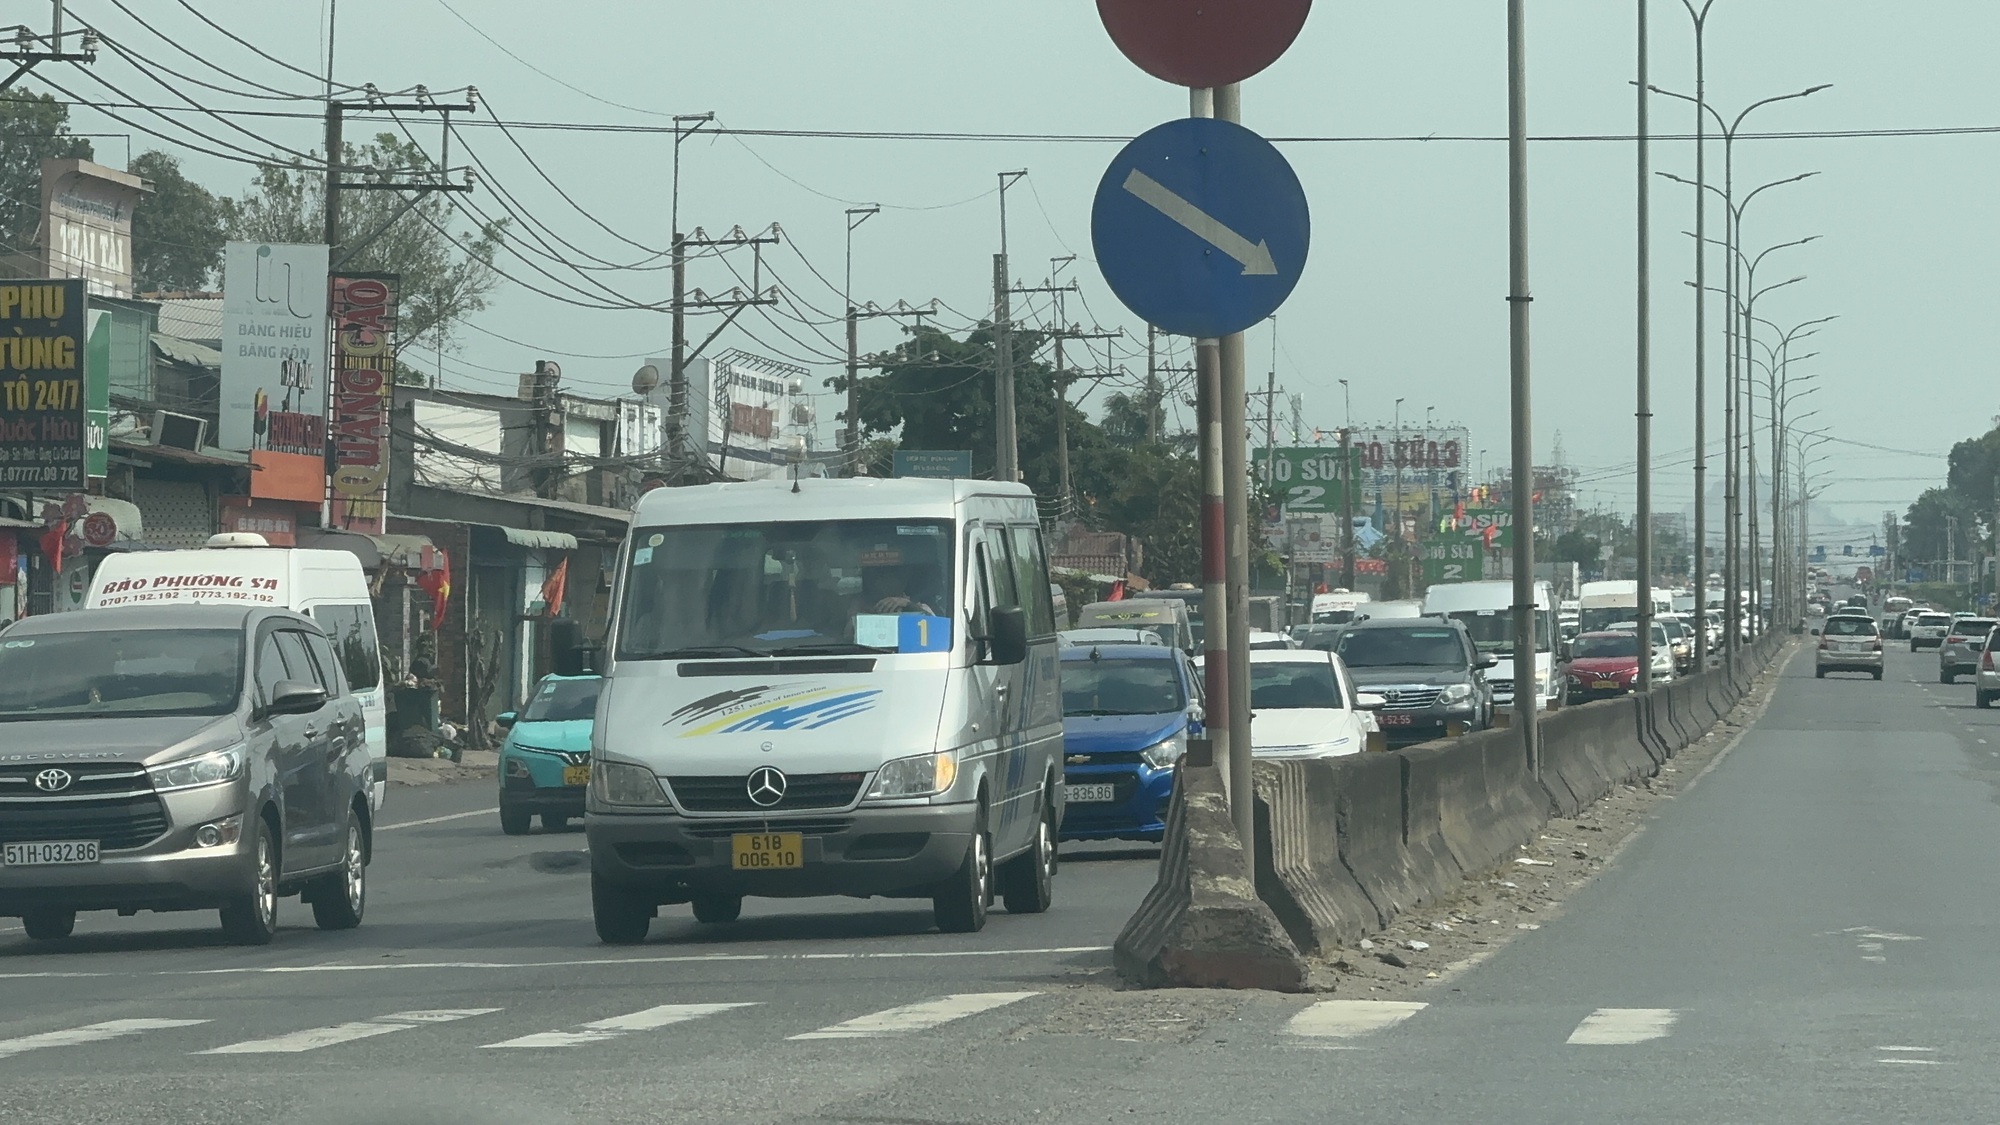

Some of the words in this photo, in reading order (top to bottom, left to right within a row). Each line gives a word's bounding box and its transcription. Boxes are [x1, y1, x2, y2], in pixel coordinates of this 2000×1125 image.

[0, 285, 65, 328] PHỤ
[238, 320, 276, 337] BẢNG
[280, 323, 312, 341] HIỆU
[239, 342, 276, 358] BĂNG
[4, 373, 29, 411] TÔ
[34, 379, 79, 411] 24/7
[60, 466, 78, 481] 712
[1287, 485, 1326, 508] 2
[1443, 564, 1462, 579] 2
[102, 577, 147, 594] BẢO
[152, 573, 243, 589] PHƯƠNG
[100, 591, 180, 607] 0707.192.192
[192, 590, 274, 603] 0773.192.192
[917, 619, 928, 647] 1
[0, 752, 124, 761] ISCOVERY
[751, 835, 782, 850] 61B
[6, 843, 97, 864] 51H-032.86
[739, 851, 795, 867] 006.10
